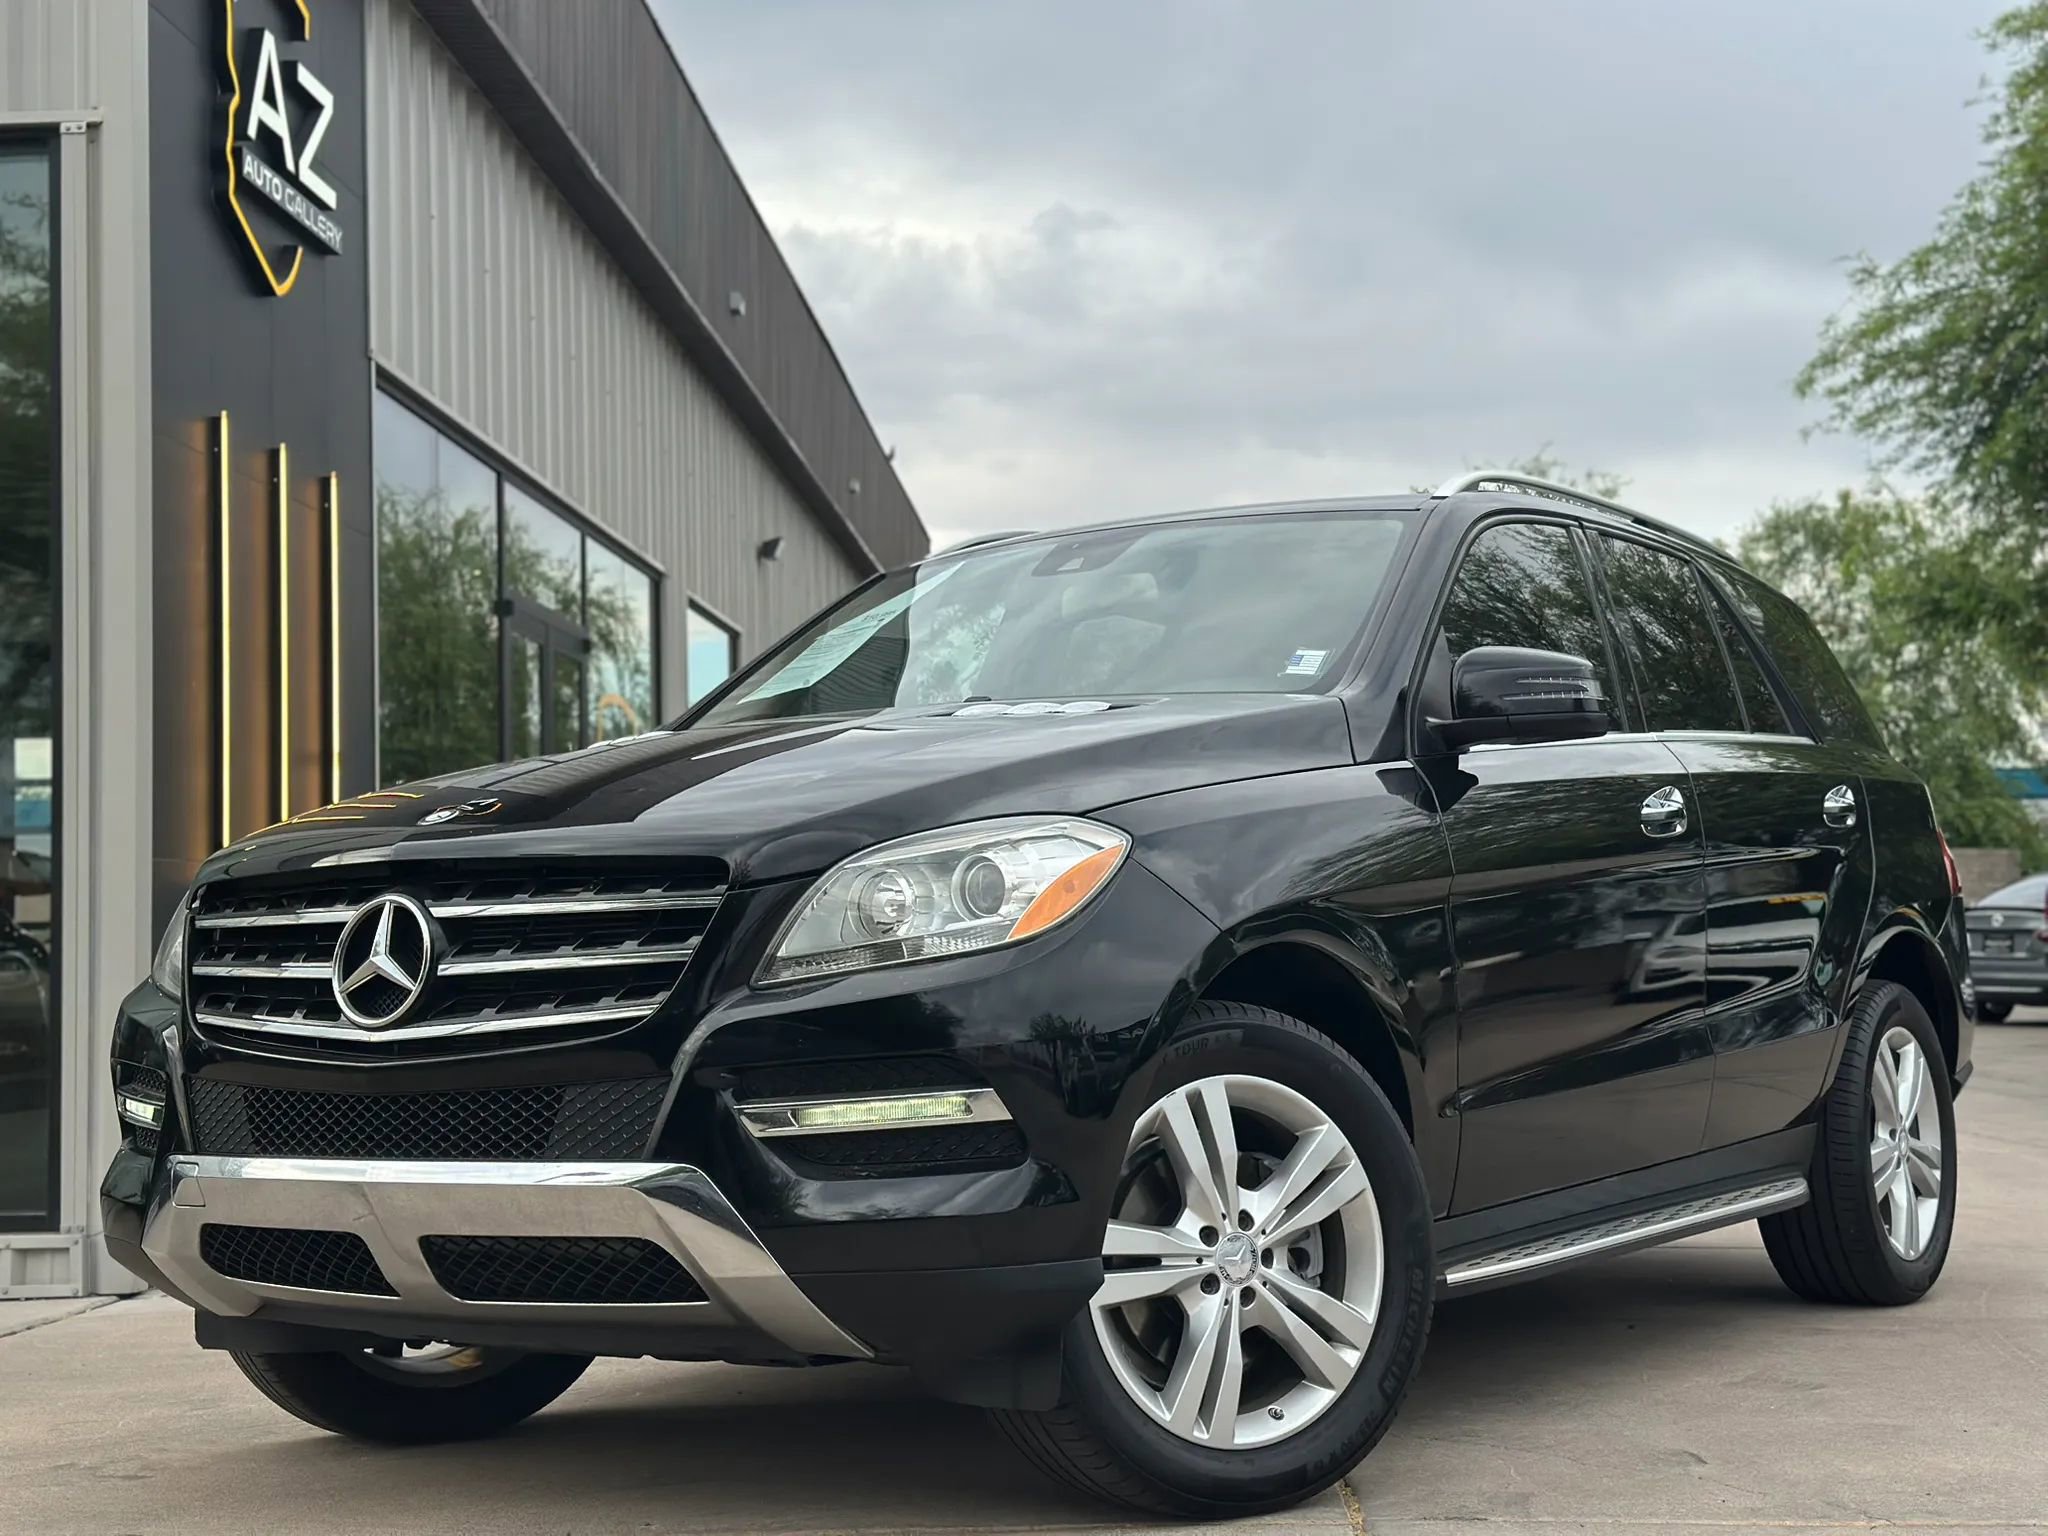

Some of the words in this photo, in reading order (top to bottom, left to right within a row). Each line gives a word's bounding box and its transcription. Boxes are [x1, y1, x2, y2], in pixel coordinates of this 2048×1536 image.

[247, 29, 337, 210] AZ
[243, 154, 283, 200] AUTO
[284, 187, 343, 248] GALLERY
